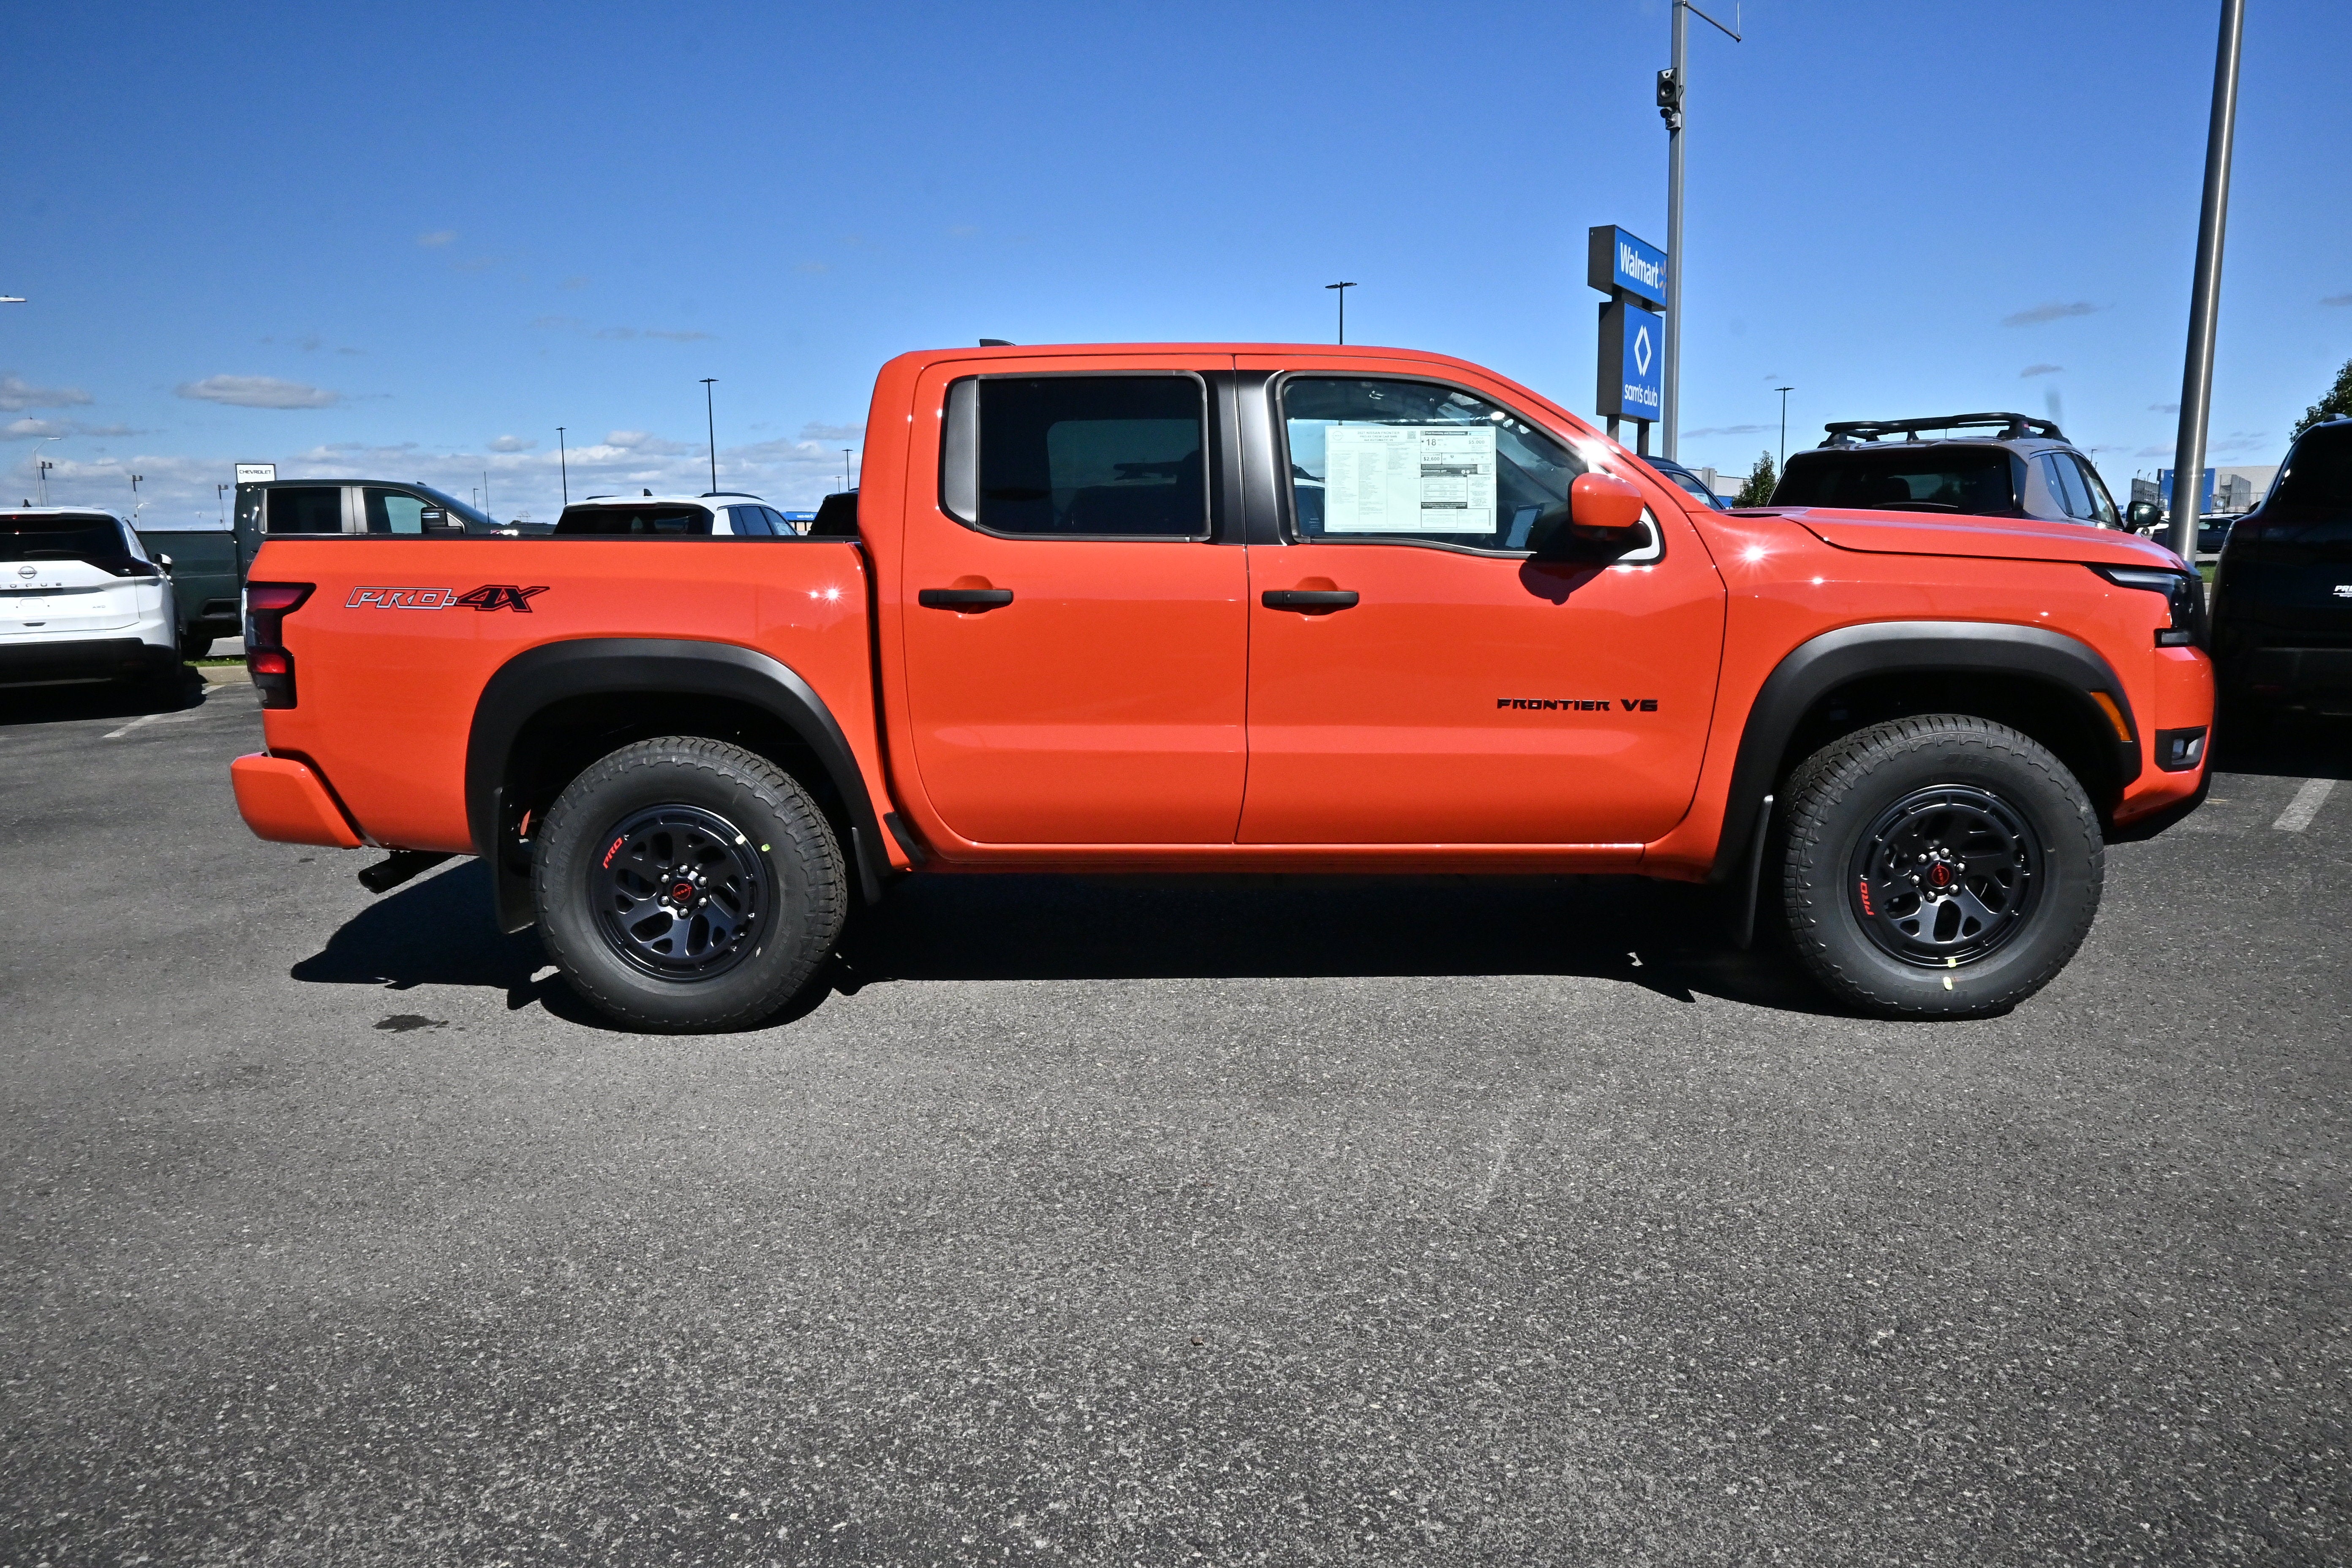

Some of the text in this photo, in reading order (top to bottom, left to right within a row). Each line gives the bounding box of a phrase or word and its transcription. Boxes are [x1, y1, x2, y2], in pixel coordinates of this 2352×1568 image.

[1620, 242, 1658, 289] Walmart
[1625, 384, 1658, 407] sam's club
[345, 585, 550, 613] PRO-4X
[1497, 698, 1658, 711] FRONTIER V6
[603, 837, 623, 869] PRO
[1860, 882, 1875, 915] PRO
